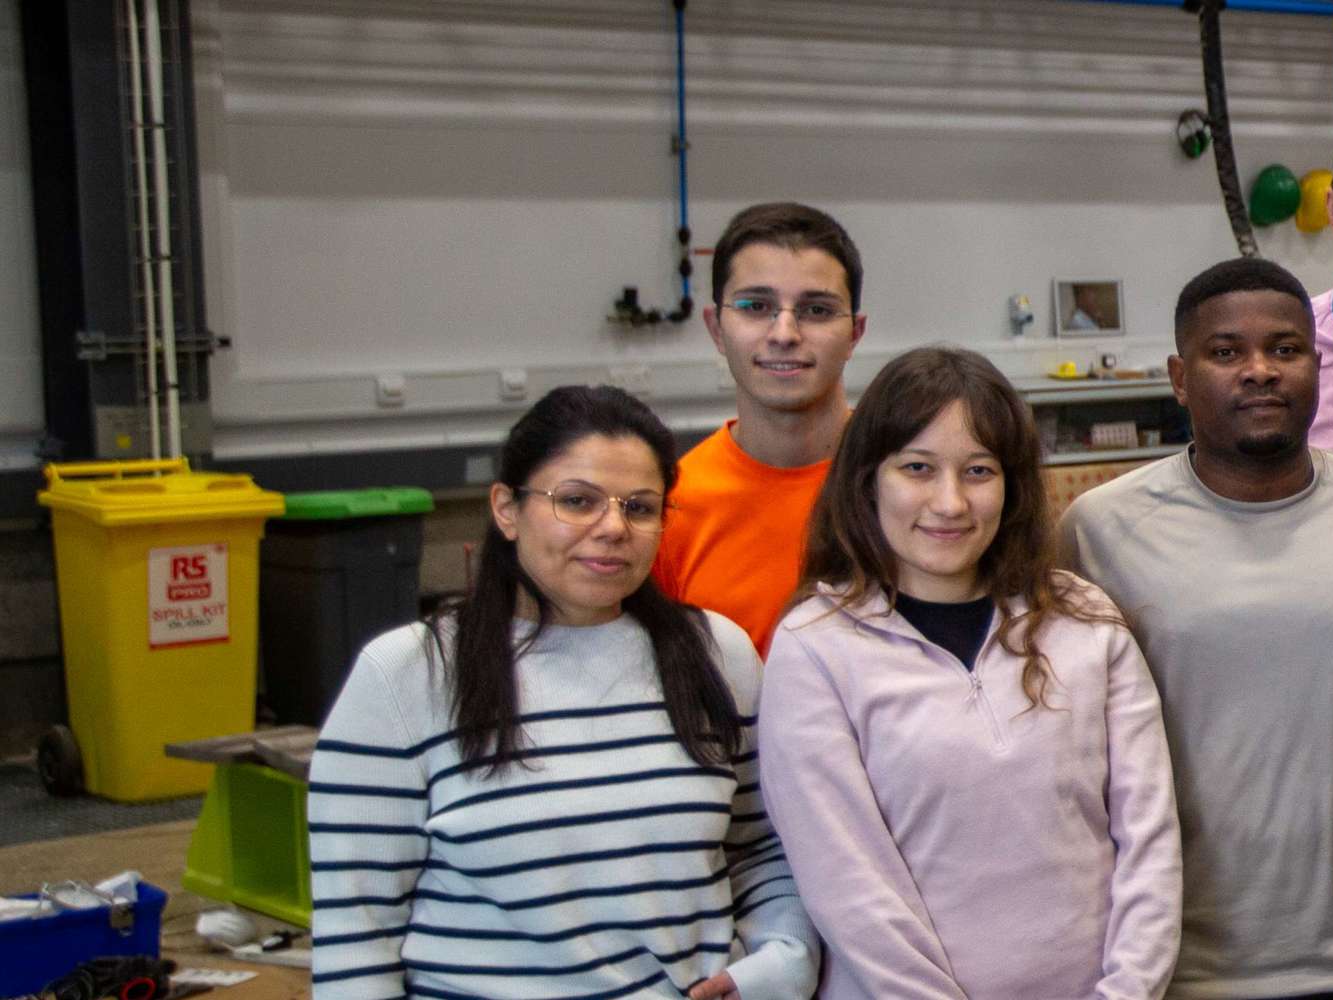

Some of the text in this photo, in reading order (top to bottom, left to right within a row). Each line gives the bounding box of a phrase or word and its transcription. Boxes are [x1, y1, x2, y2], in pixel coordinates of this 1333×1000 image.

[171, 554, 209, 580] RS
[152, 603, 225, 621] SPILL KIT
